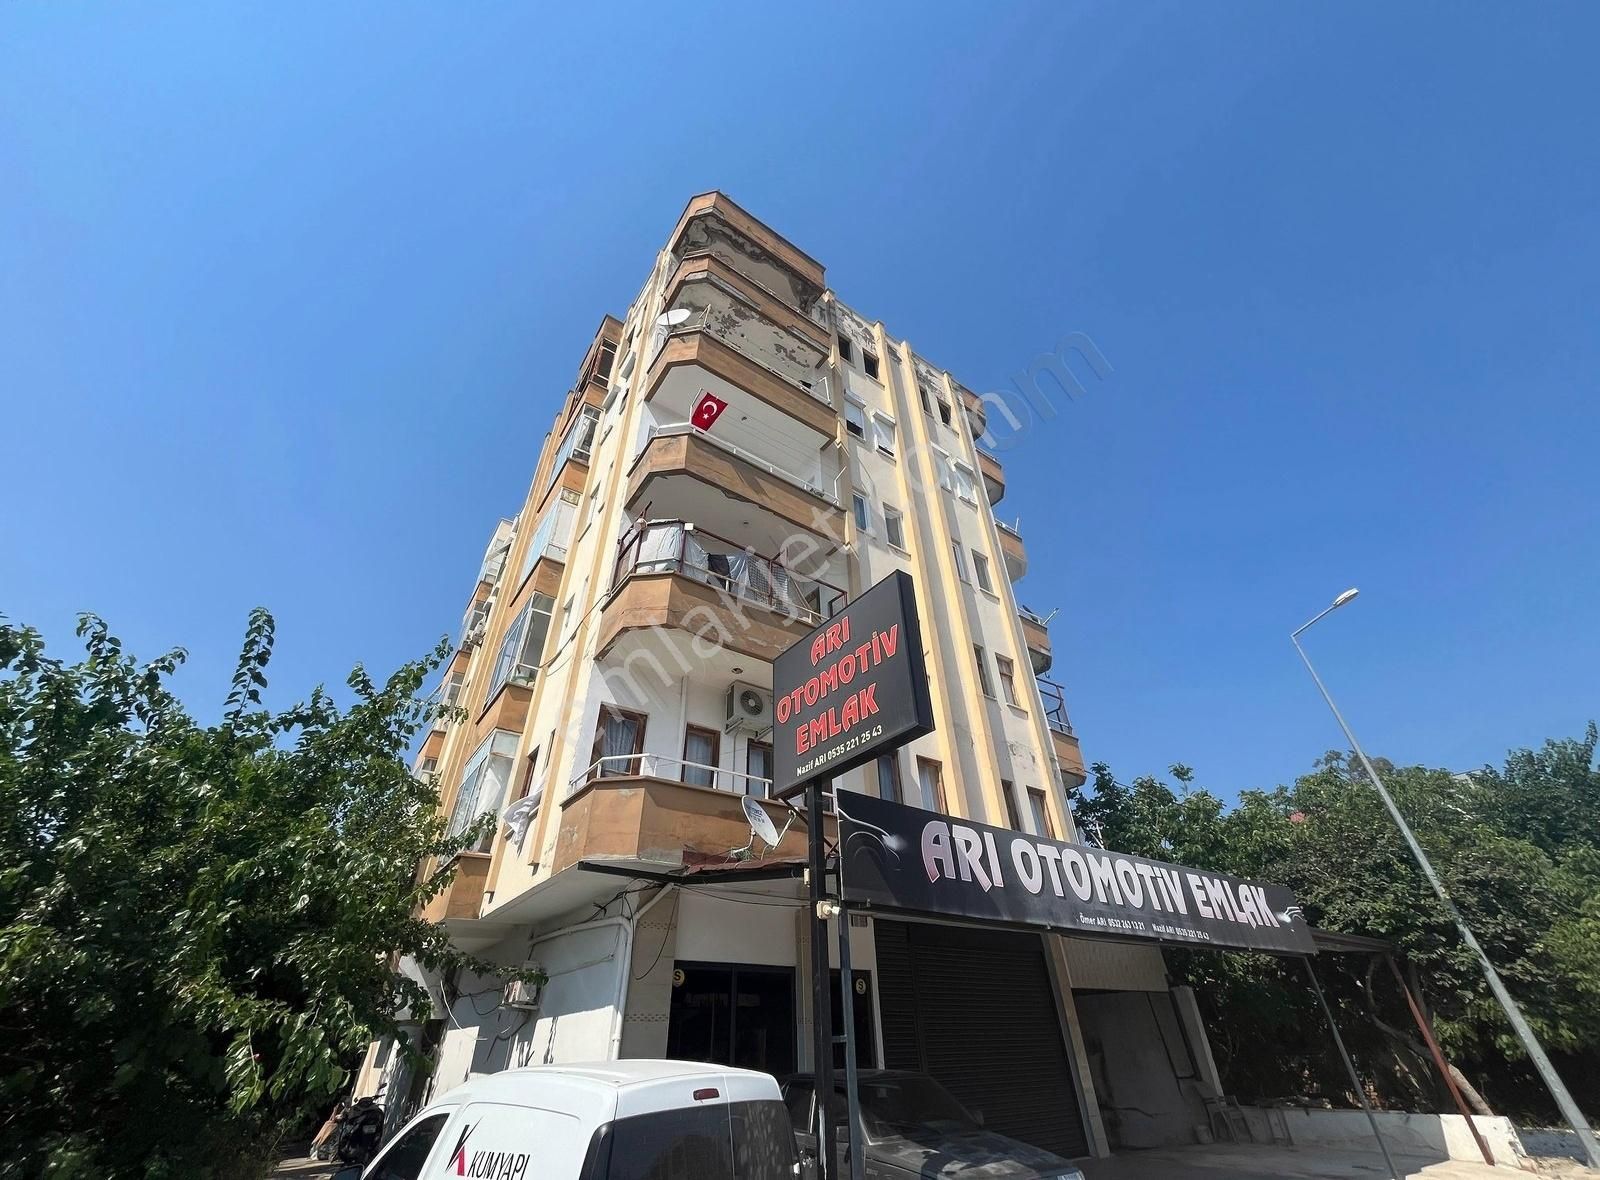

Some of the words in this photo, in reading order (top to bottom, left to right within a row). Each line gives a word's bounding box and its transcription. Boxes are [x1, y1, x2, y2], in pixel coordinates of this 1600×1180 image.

[810, 616, 850, 666] ARI
[776, 624, 898, 724] OTOMOTİV
[795, 683, 880, 755] EMLAK
[796, 760, 814, 776] Nazif
[814, 753, 827, 768] ARI
[827, 743, 845, 760] 0535
[846, 736, 859, 752] 221
[861, 730, 871, 744] 25
[872, 725, 882, 737] 43
[921, 820, 1004, 893] ARI
[1186, 873, 1281, 929] EMLAK
[1080, 912, 1096, 925] Ömer
[1097, 917, 1107, 926] ARI
[1107, 918, 1122, 928] 0532
[1122, 920, 1131, 929] 263
[1132, 921, 1139, 930] 13
[1139, 922, 1145, 931] 21
[1152, 923, 1165, 933] Nazif
[1165, 926, 1175, 935] ARI
[467, 1150, 531, 1180] KUMYAPI
